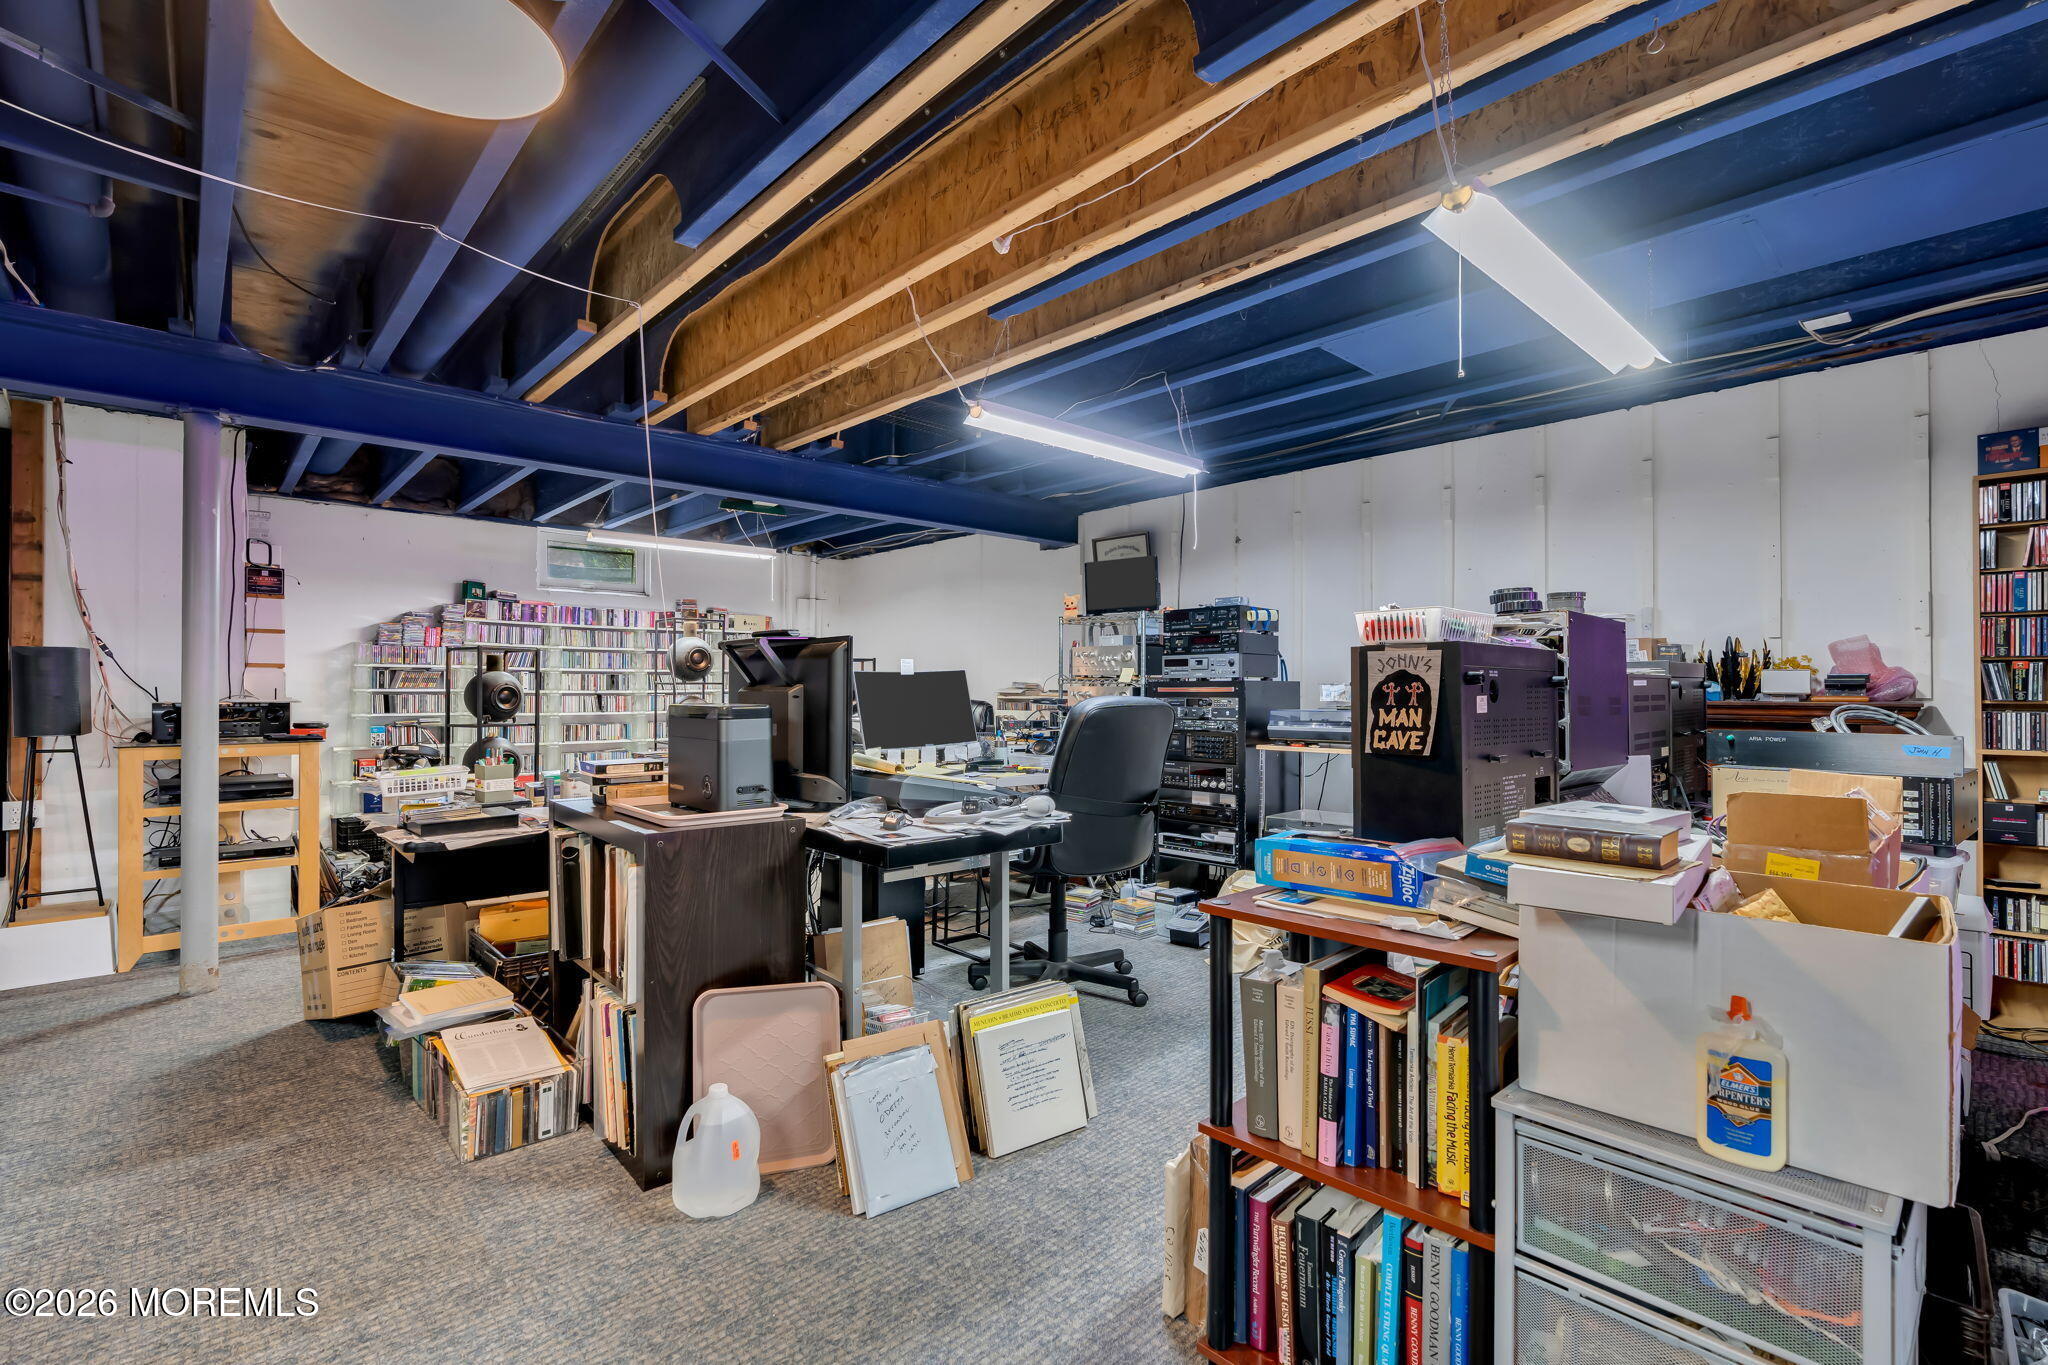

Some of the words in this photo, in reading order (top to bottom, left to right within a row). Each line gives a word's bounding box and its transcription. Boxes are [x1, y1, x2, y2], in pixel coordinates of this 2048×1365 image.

[1377, 653, 1433, 673] JOHN'S
[1378, 708, 1422, 727] MAN
[1373, 730, 1424, 750] CAVE
[1398, 863, 1416, 903] Ziploc
[337, 968, 367, 977] CONTENTS
[1039, 999, 1066, 1010] CONCERTO
[1304, 1006, 1314, 1035] JUSSI
[1325, 1026, 1334, 1053] Casta
[1348, 1026, 1356, 1047] SUMAC
[1448, 1046, 1456, 1062] Henri
[1366, 1058, 1374, 1084] Language
[1448, 1062, 1456, 1090] Temianka
[1366, 1093, 1374, 1108] Vinyl
[1444, 1091, 1458, 1121] Facing
[1718, 1088, 1771, 1107] RPENTER'S
[1446, 1122, 1458, 1138] the
[1445, 1140, 1458, 1166] Music
[1278, 1225, 1288, 1290] RECOLLECTIONS
[1336, 1249, 1346, 1274] Gregor
[1430, 1244, 1440, 1289] BENNY
[1252, 1268, 1260, 1295] Record
[1298, 1244, 1308, 1308] Feuermann
[1306, 1262, 1314, 1288] Emanuel
[1384, 1263, 1394, 1309] COMPLETE
[1280, 1290, 1290, 1301] OF
[1324, 1314, 1332, 1336] Gospel
[1382, 1310, 1392, 1342] STRING
[1410, 1306, 1418, 1336] BENNY
[1428, 1290, 1440, 1360] GOODMAN
[1454, 1317, 1463, 1342] BENNY
